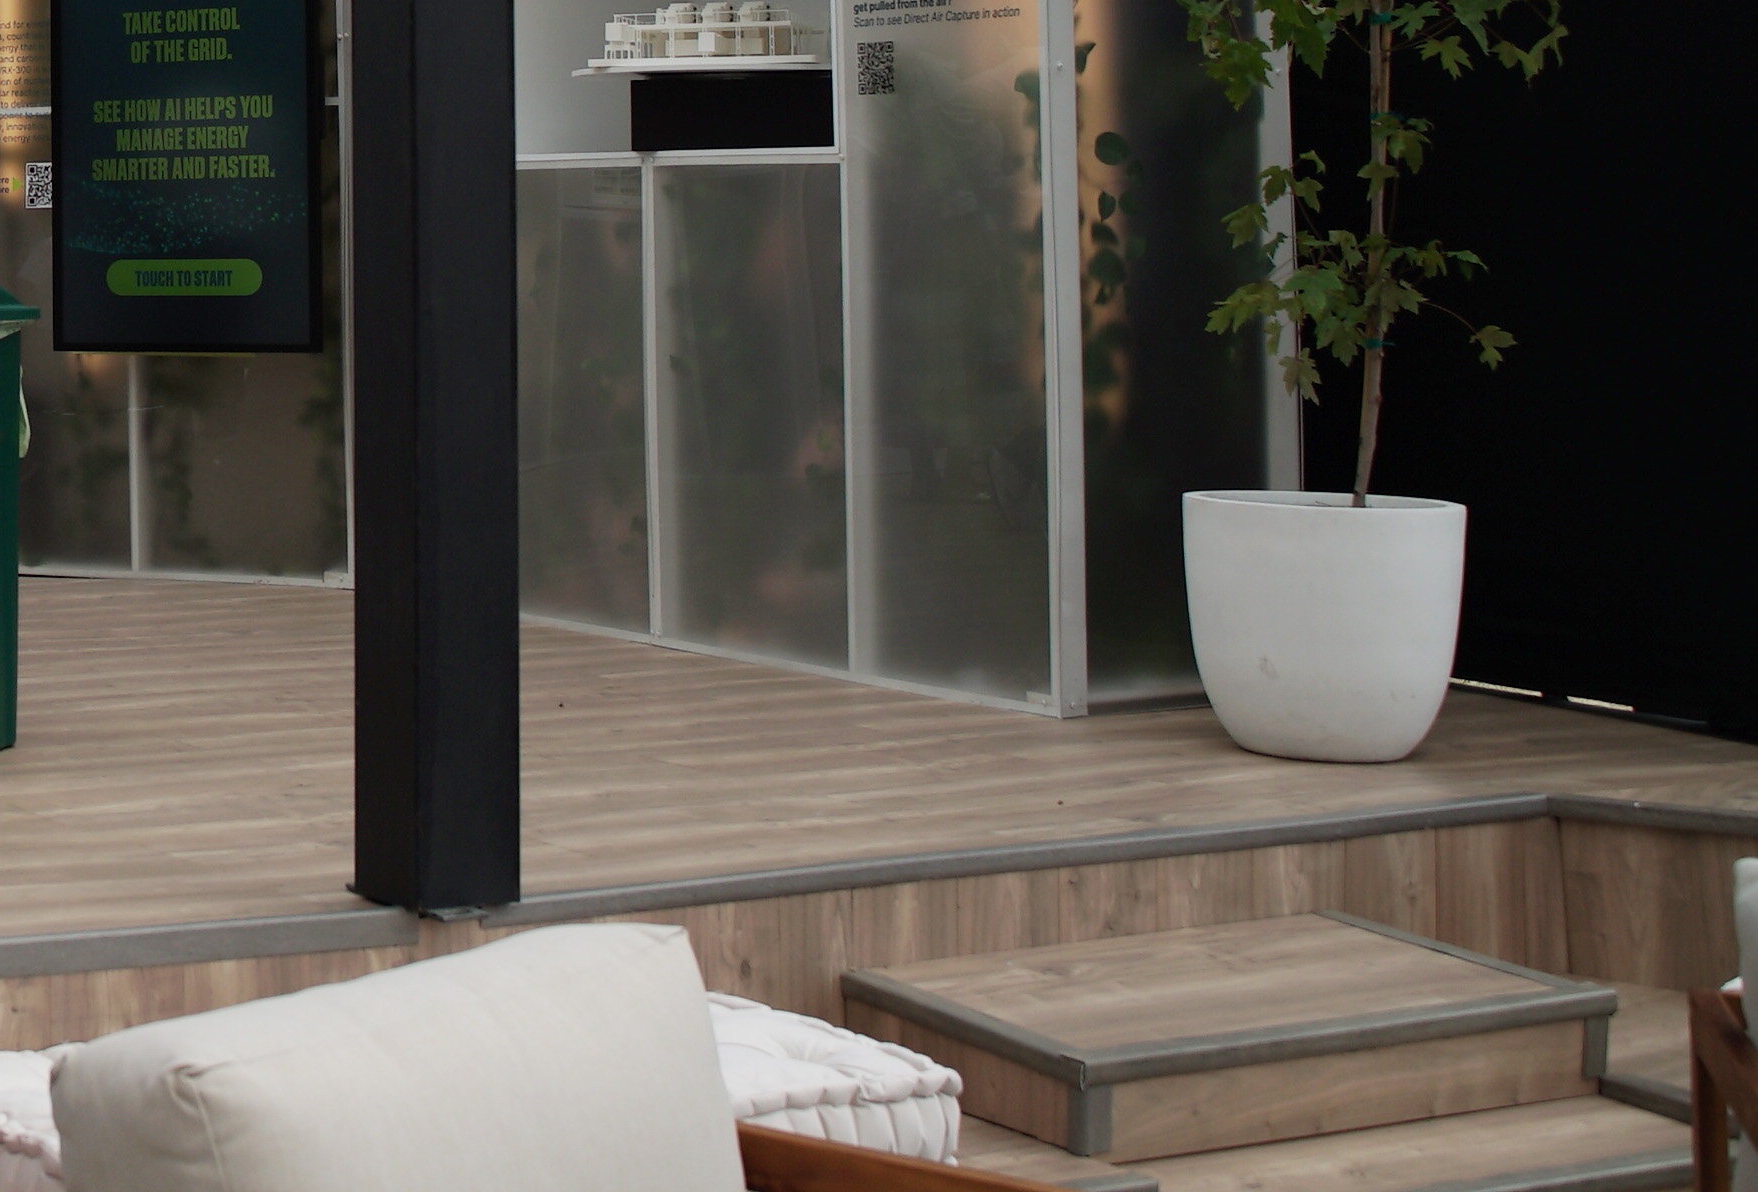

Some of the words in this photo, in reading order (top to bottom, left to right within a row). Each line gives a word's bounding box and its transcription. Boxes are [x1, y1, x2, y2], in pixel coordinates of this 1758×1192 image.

[123, 10, 162, 35] TAKE
[165, 7, 241, 33] CONTROL
[853, 2, 868, 15] get
[869, 0, 896, 14] pulled
[853, 16, 875, 28] Scan
[876, 15, 885, 26] to
[887, 16, 903, 26] see
[904, 13, 930, 25] Direct
[930, 11, 944, 22] Air
[945, 9, 981, 23] Capture
[982, 7, 991, 19] in
[992, 5, 1021, 19] action
[130, 40, 150, 64] OF
[154, 39, 185, 63] THE
[188, 37, 233, 62] GRID.
[93, 99, 121, 123] SEE
[124, 98, 161, 122] HOW
[164, 97, 181, 121] AI
[184, 95, 237, 120] HELPS
[239, 94, 274, 119] YOU
[116, 127, 184, 152] MANAGE
[186, 125, 250, 150] ENERGY
[92, 157, 169, 182] SMARTER
[172, 156, 206, 180] AND
[209, 154, 277, 179] FASTER.
[135, 270, 174, 287] TOUCH
[176, 270, 191, 287] TO
[194, 269, 233, 287] START
